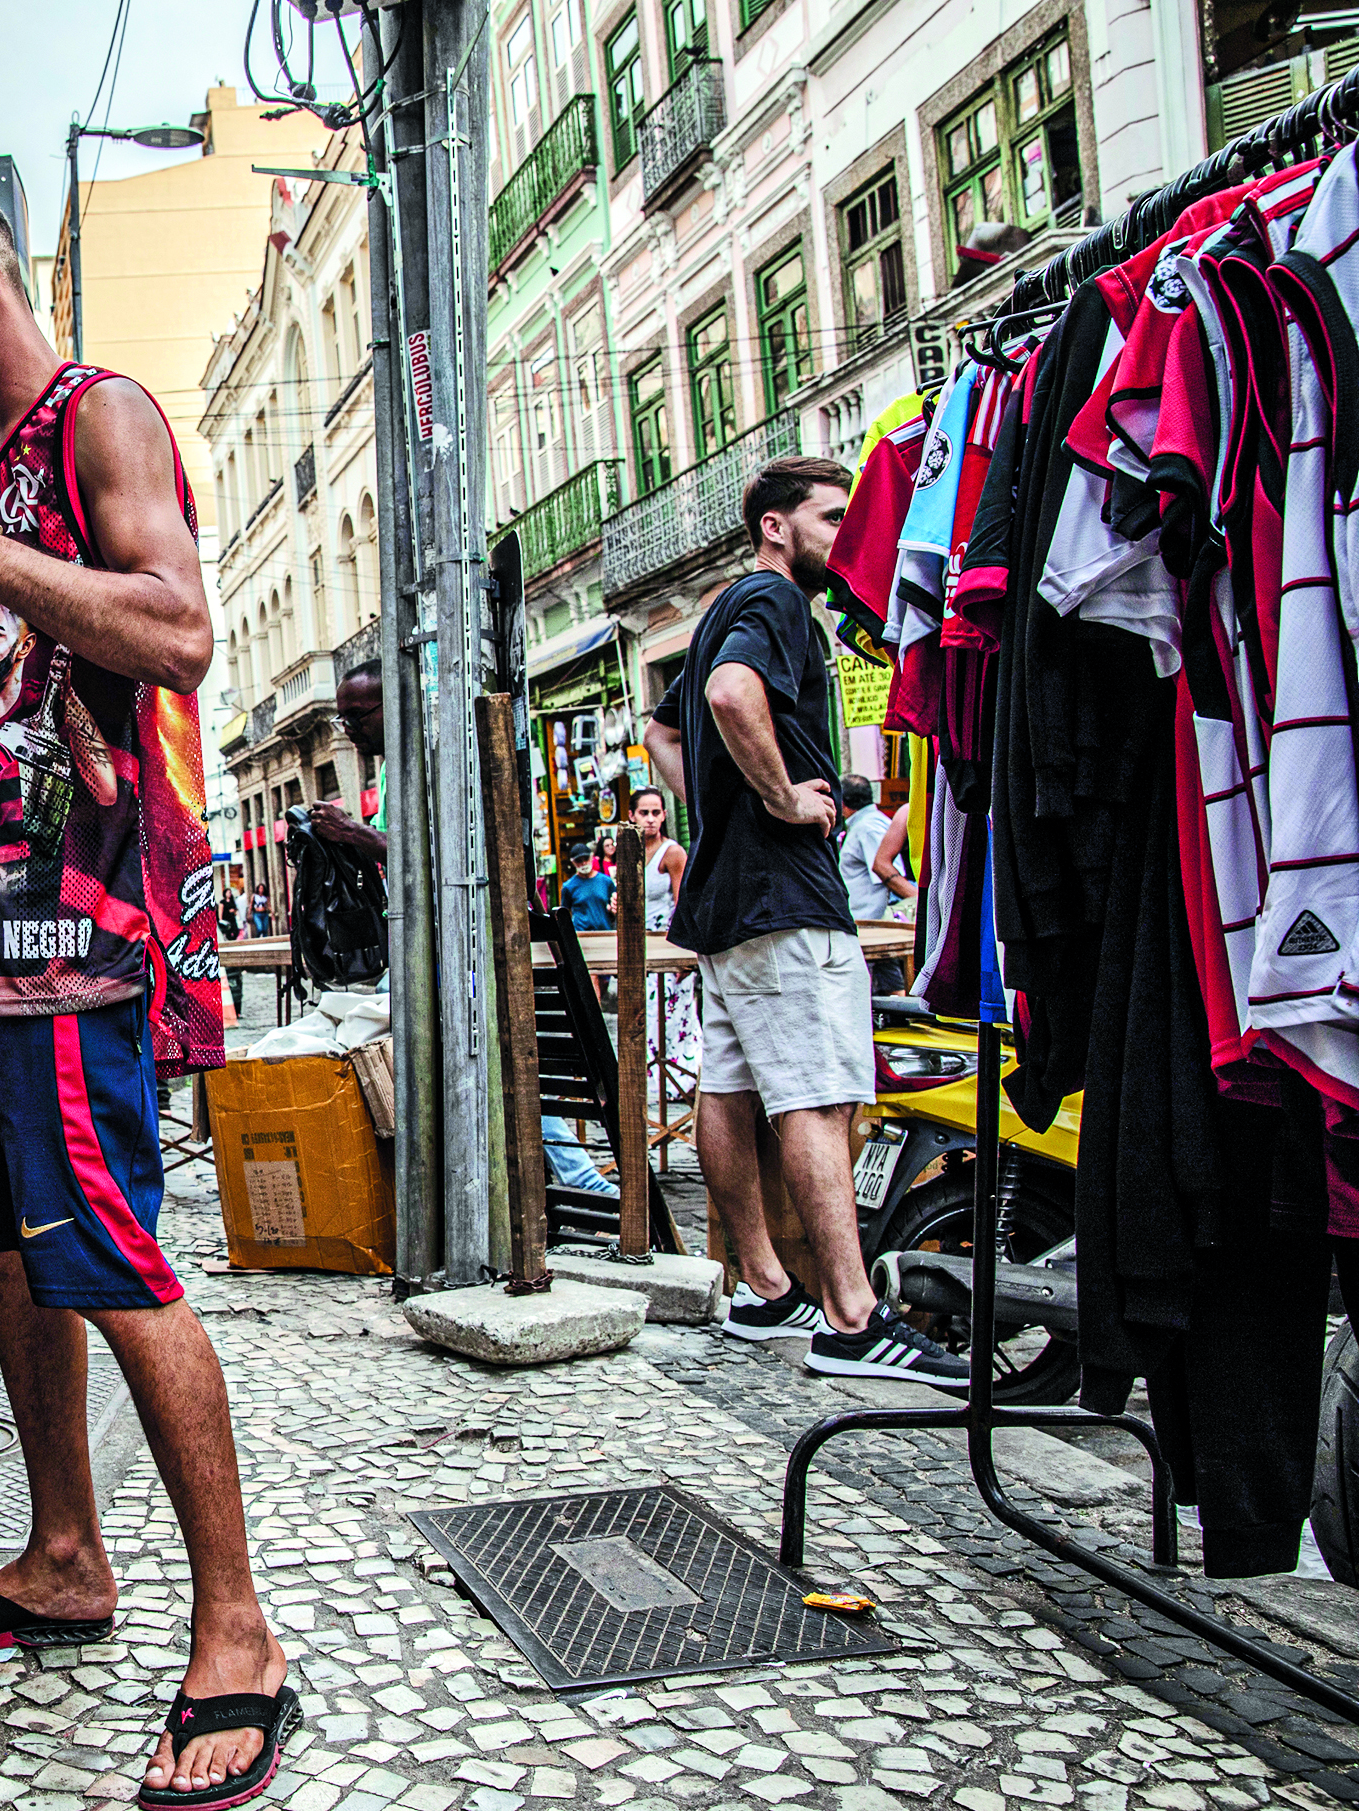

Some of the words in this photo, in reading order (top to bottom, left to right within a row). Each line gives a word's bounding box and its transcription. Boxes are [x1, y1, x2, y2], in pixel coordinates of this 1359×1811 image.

[844, 676, 856, 685] EM
[859, 672, 876, 683] ATÉ
[3, 917, 93, 959] NEGRO
[862, 1144, 890, 1172] NYA
[213, 1706, 270, 1720] FLAMEN
